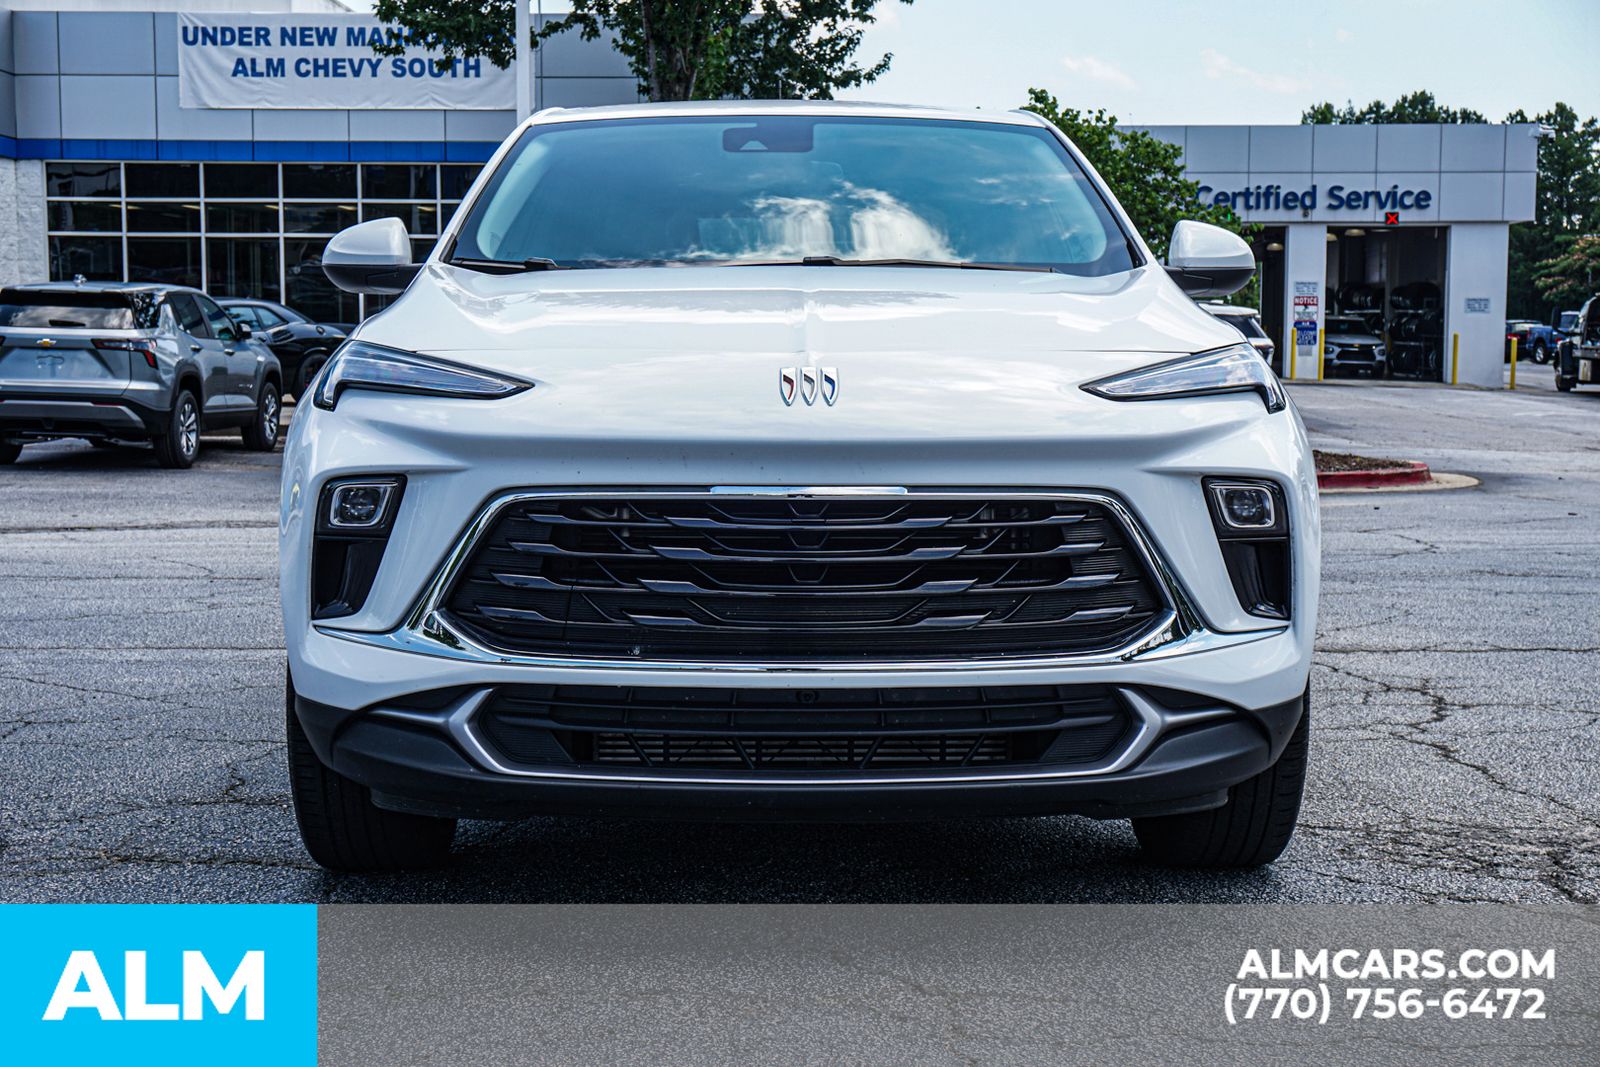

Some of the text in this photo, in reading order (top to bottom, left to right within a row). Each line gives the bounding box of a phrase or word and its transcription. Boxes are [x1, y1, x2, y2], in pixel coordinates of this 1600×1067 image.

[182, 26, 271, 46] UNDER
[280, 26, 338, 46] NEW
[231, 57, 481, 78] ALM CHEVY SOUTH
[1195, 184, 1432, 210] Certified Service
[1294, 297, 1318, 305] NOTICE
